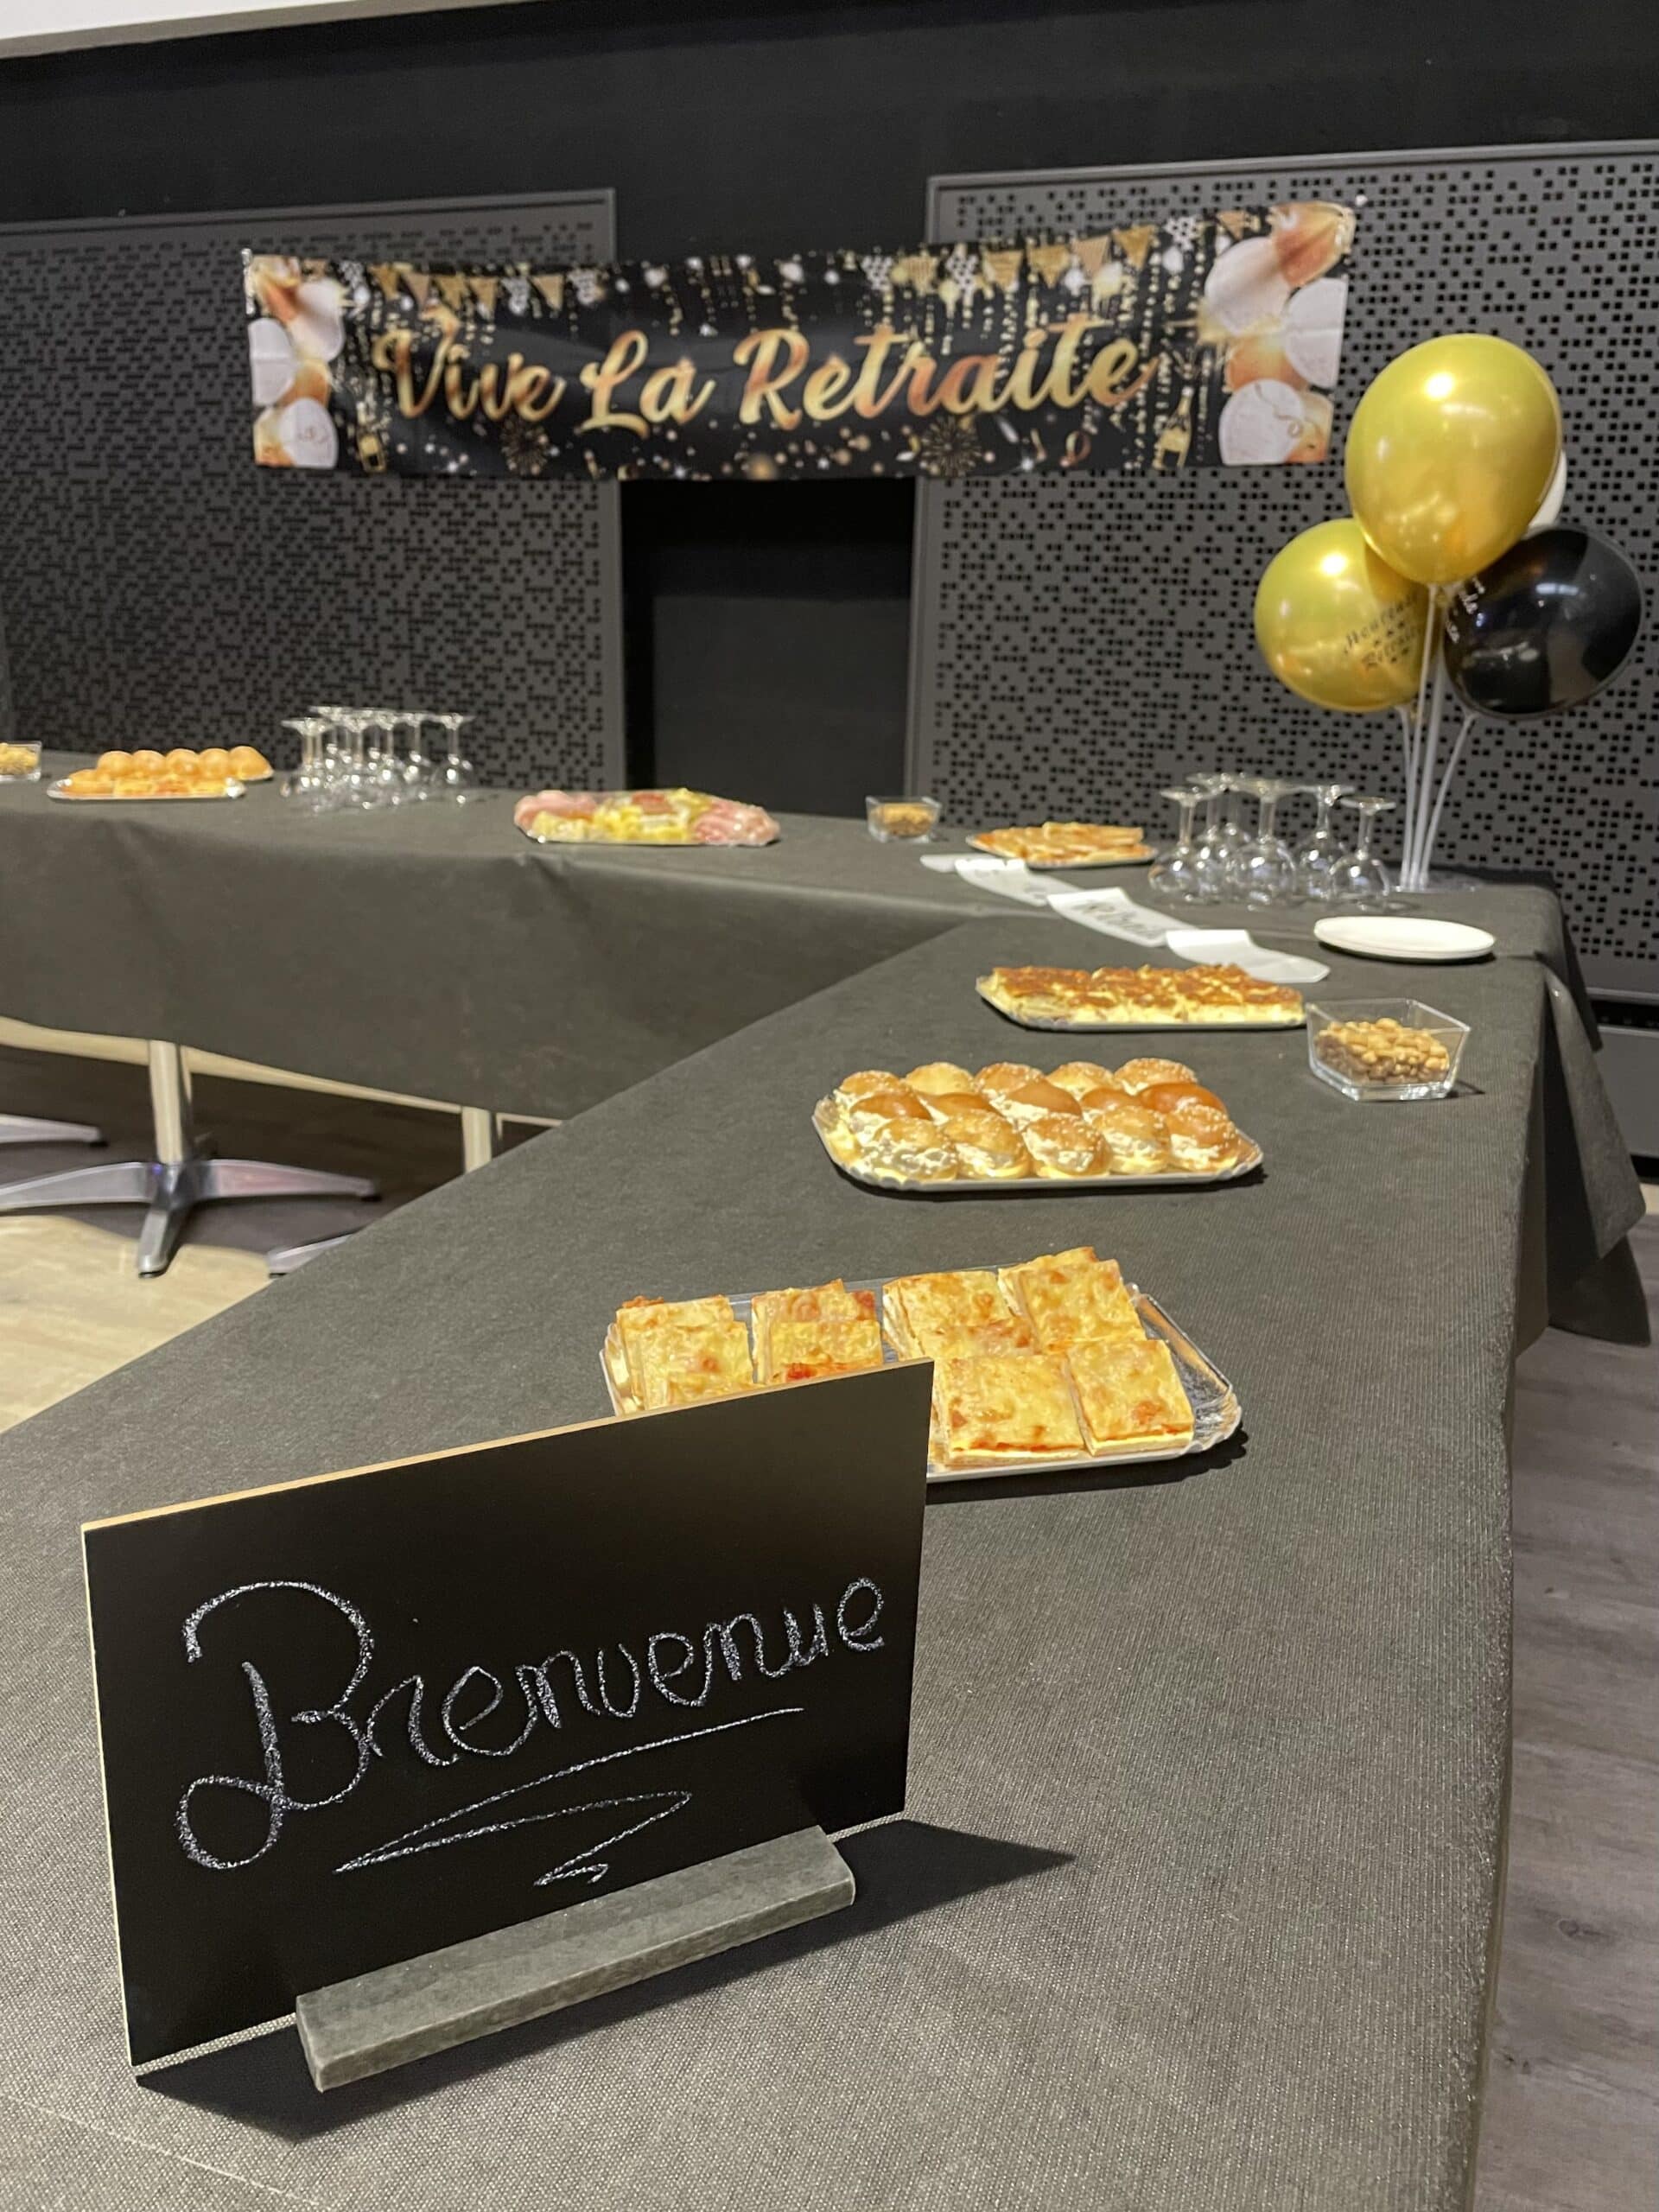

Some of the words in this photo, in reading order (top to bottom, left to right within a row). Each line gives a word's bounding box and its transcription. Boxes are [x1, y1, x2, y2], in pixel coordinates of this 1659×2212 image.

[372, 303, 566, 420] Vive
[580, 329, 715, 439] La
[733, 314, 1159, 429] Retraite
[176, 1578, 886, 1871] Bienvenue
